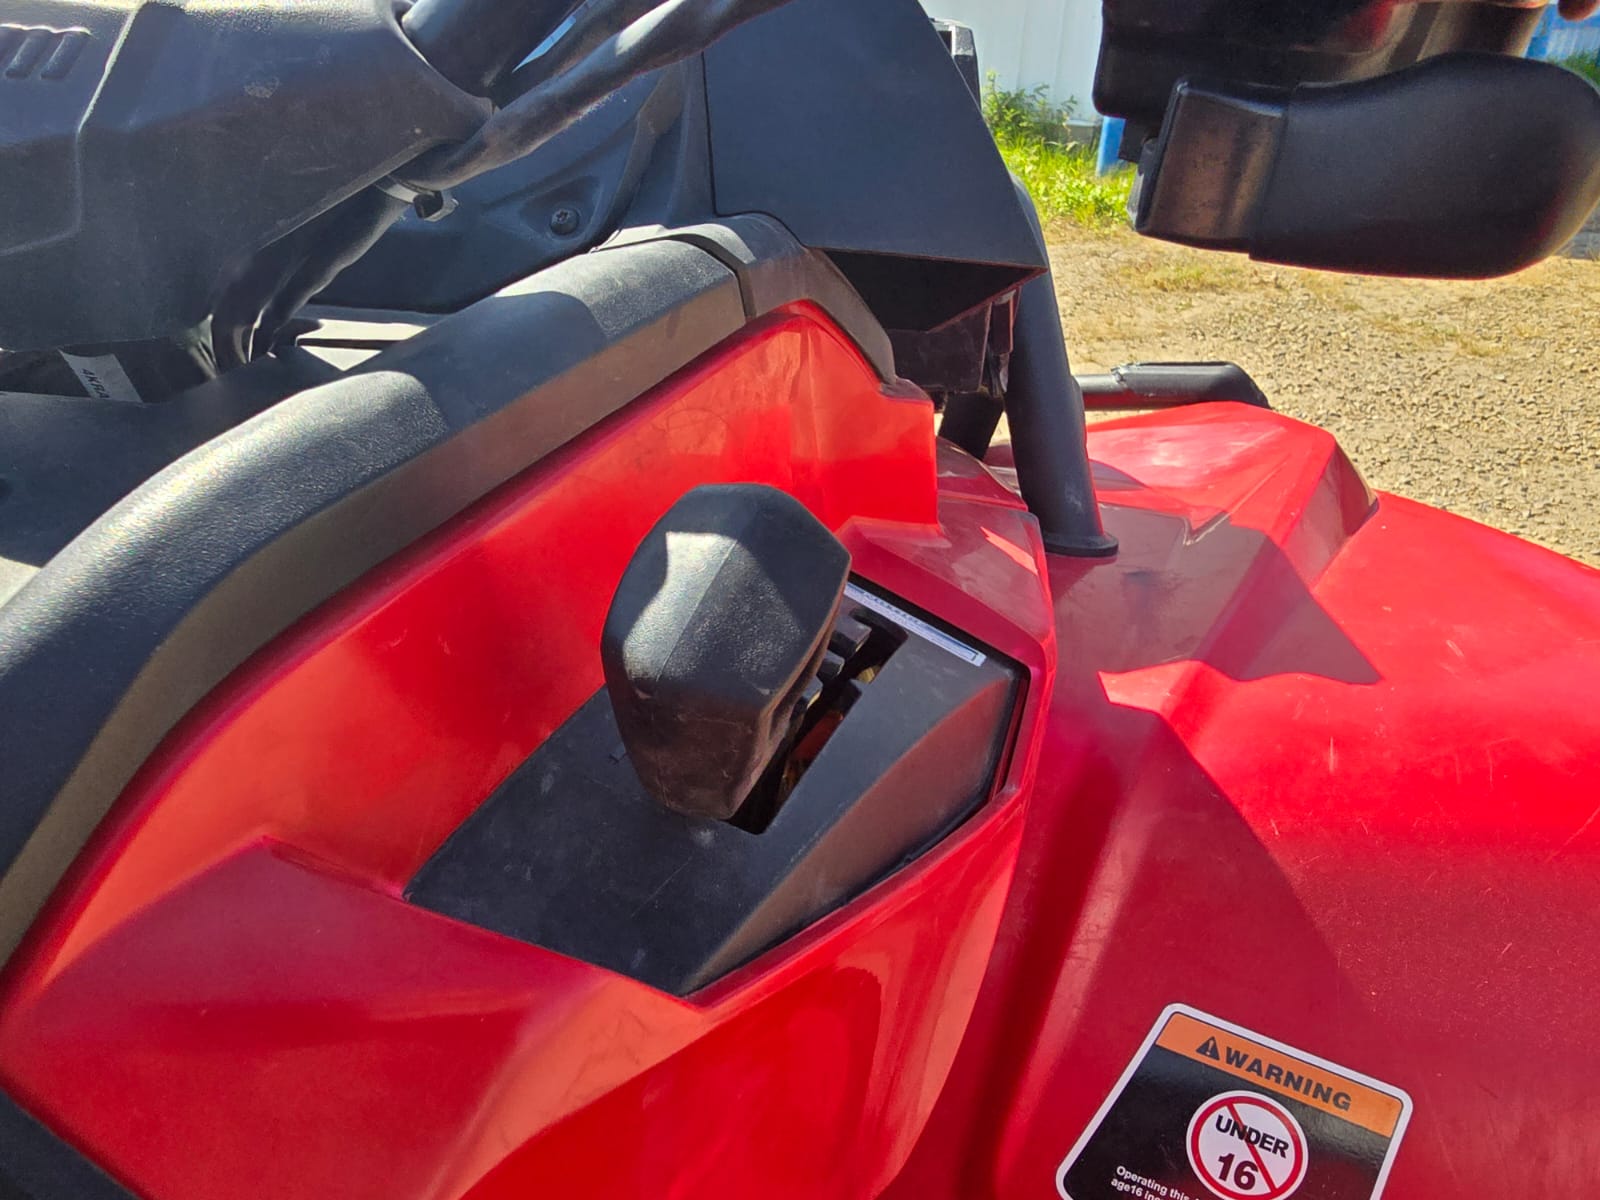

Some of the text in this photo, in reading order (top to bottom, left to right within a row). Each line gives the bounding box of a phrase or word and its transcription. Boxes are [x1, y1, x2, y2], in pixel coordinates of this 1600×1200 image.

[1226, 1046, 1351, 1111] WARNING
[1215, 1114, 1289, 1158] UNDER
[1111, 1178, 1143, 1196] age16
[1116, 1165, 1167, 1196] Operating
[1218, 1152, 1258, 1190] 16
